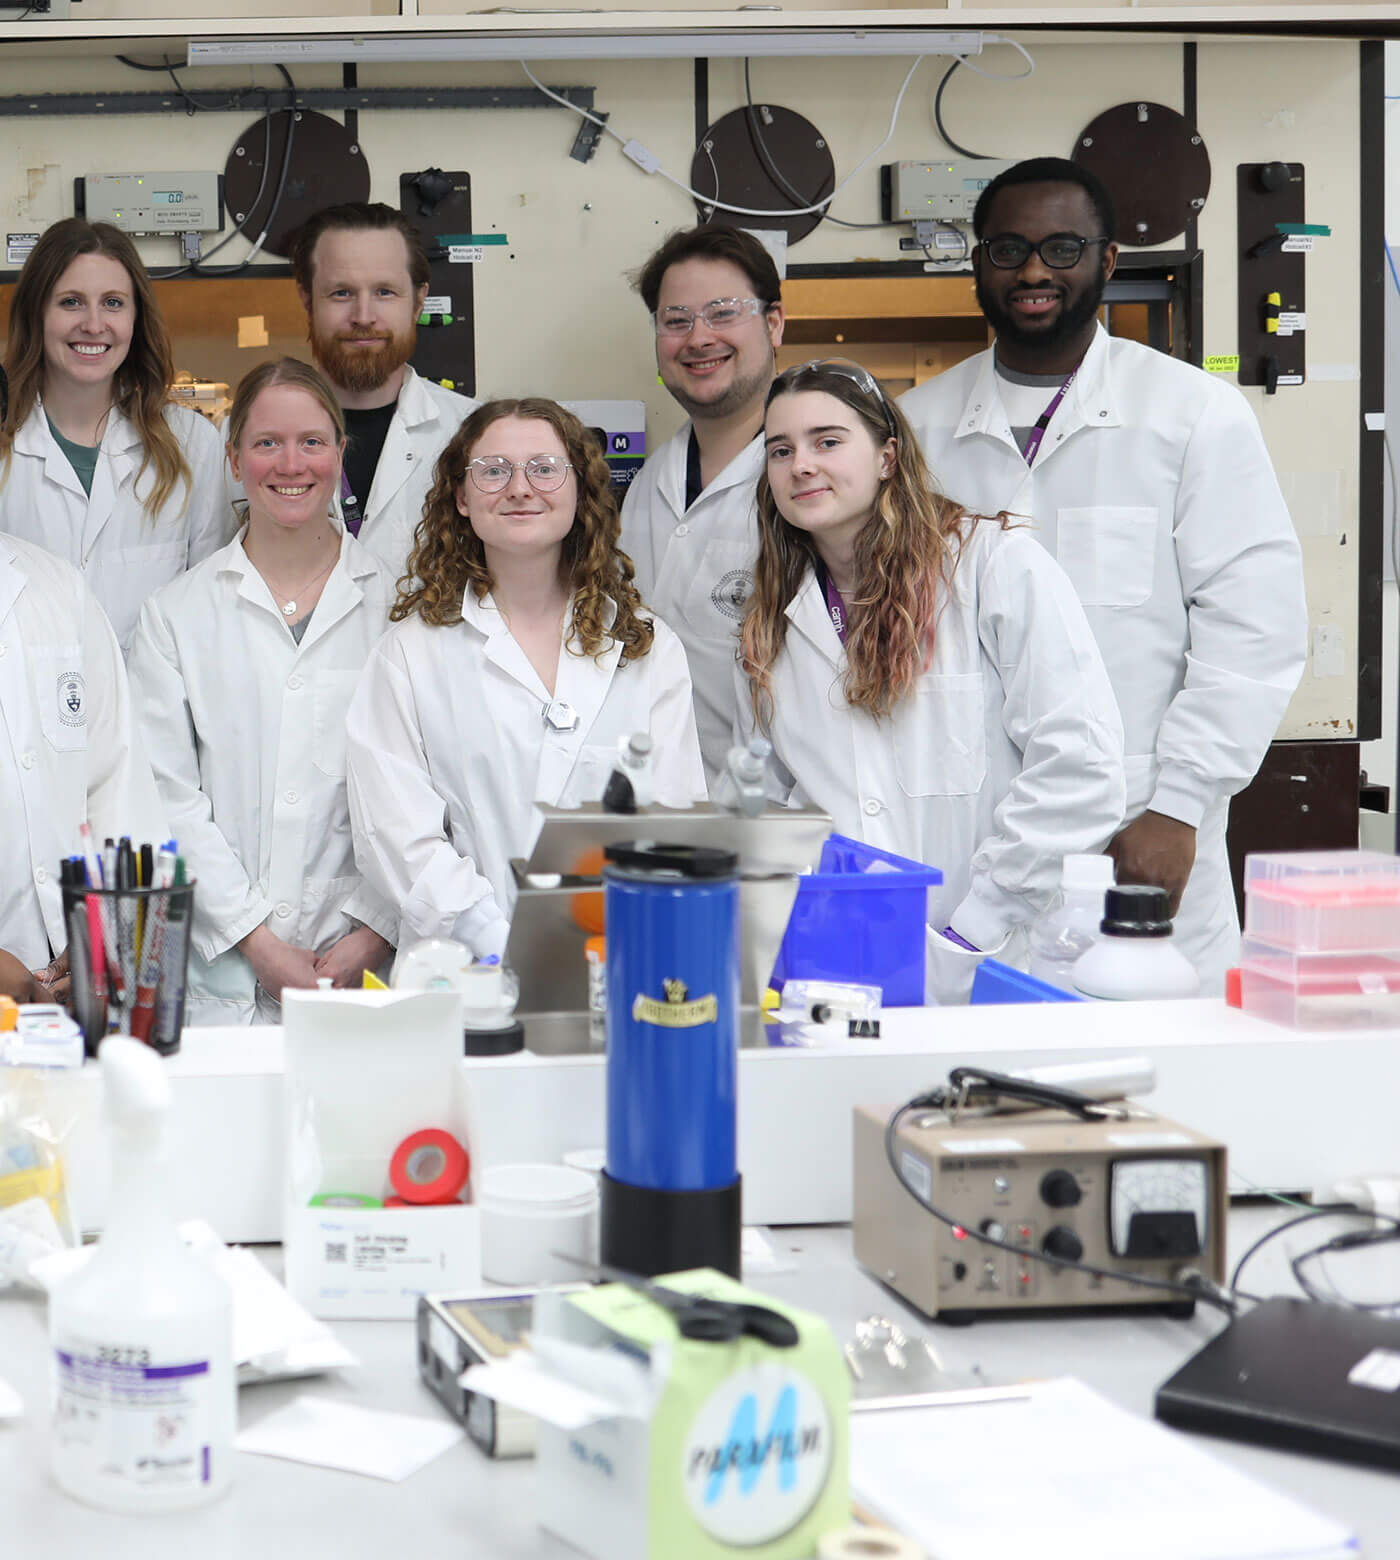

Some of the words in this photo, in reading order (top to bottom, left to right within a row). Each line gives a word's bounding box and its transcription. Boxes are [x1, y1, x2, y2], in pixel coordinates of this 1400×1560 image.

[615, 437, 627, 449] M
[831, 606, 845, 633] camh
[98, 1346, 151, 1368] 3273
[687, 1423, 822, 1483] PARAFILM
[704, 1381, 799, 1507] M
